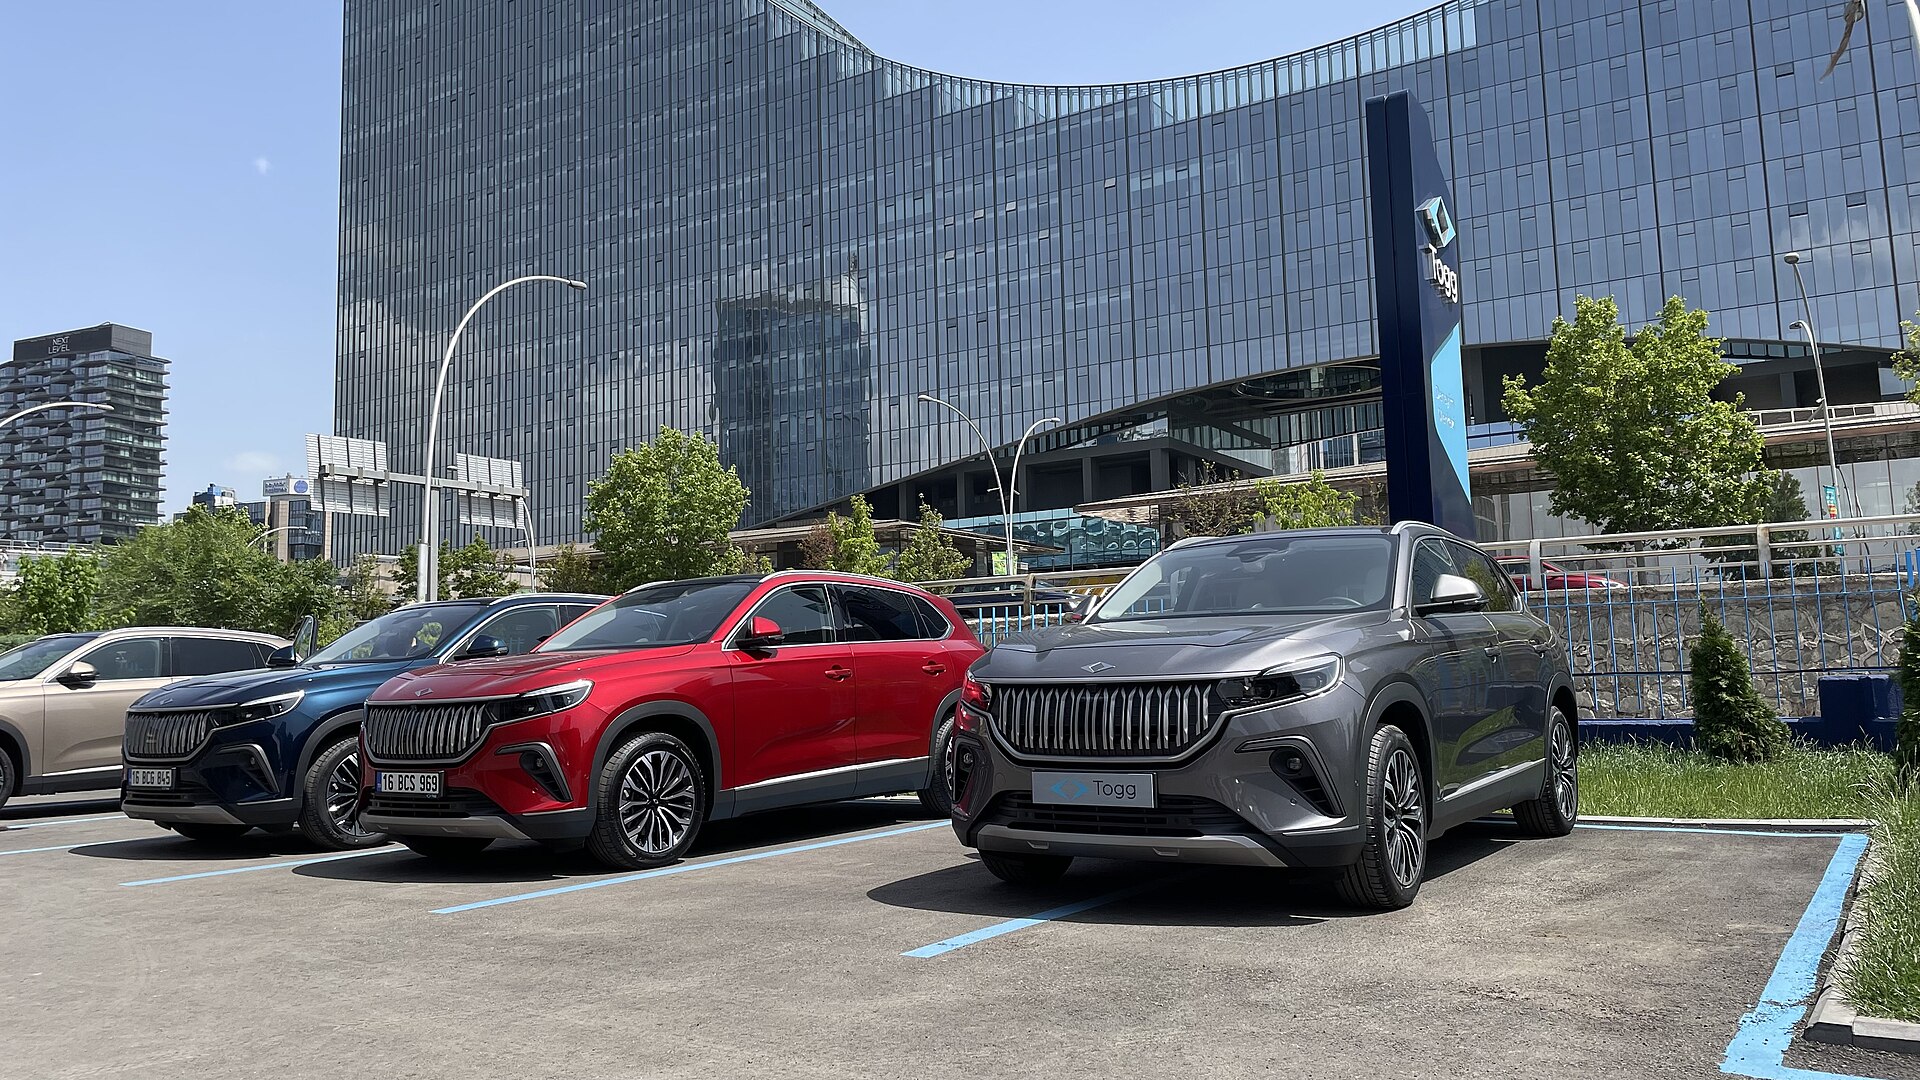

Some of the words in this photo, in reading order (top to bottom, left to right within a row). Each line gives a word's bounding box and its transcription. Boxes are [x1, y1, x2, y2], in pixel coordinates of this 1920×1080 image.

[1429, 243, 1458, 303] Togg
[53, 336, 70, 345] NEXT
[48, 344, 70, 354] LEVEL
[132, 771, 139, 785] 16
[157, 771, 170, 785] 845
[383, 774, 394, 790] 16
[398, 774, 416, 791] BCS
[420, 775, 438, 792] 969
[1093, 780, 1136, 799] Togg
